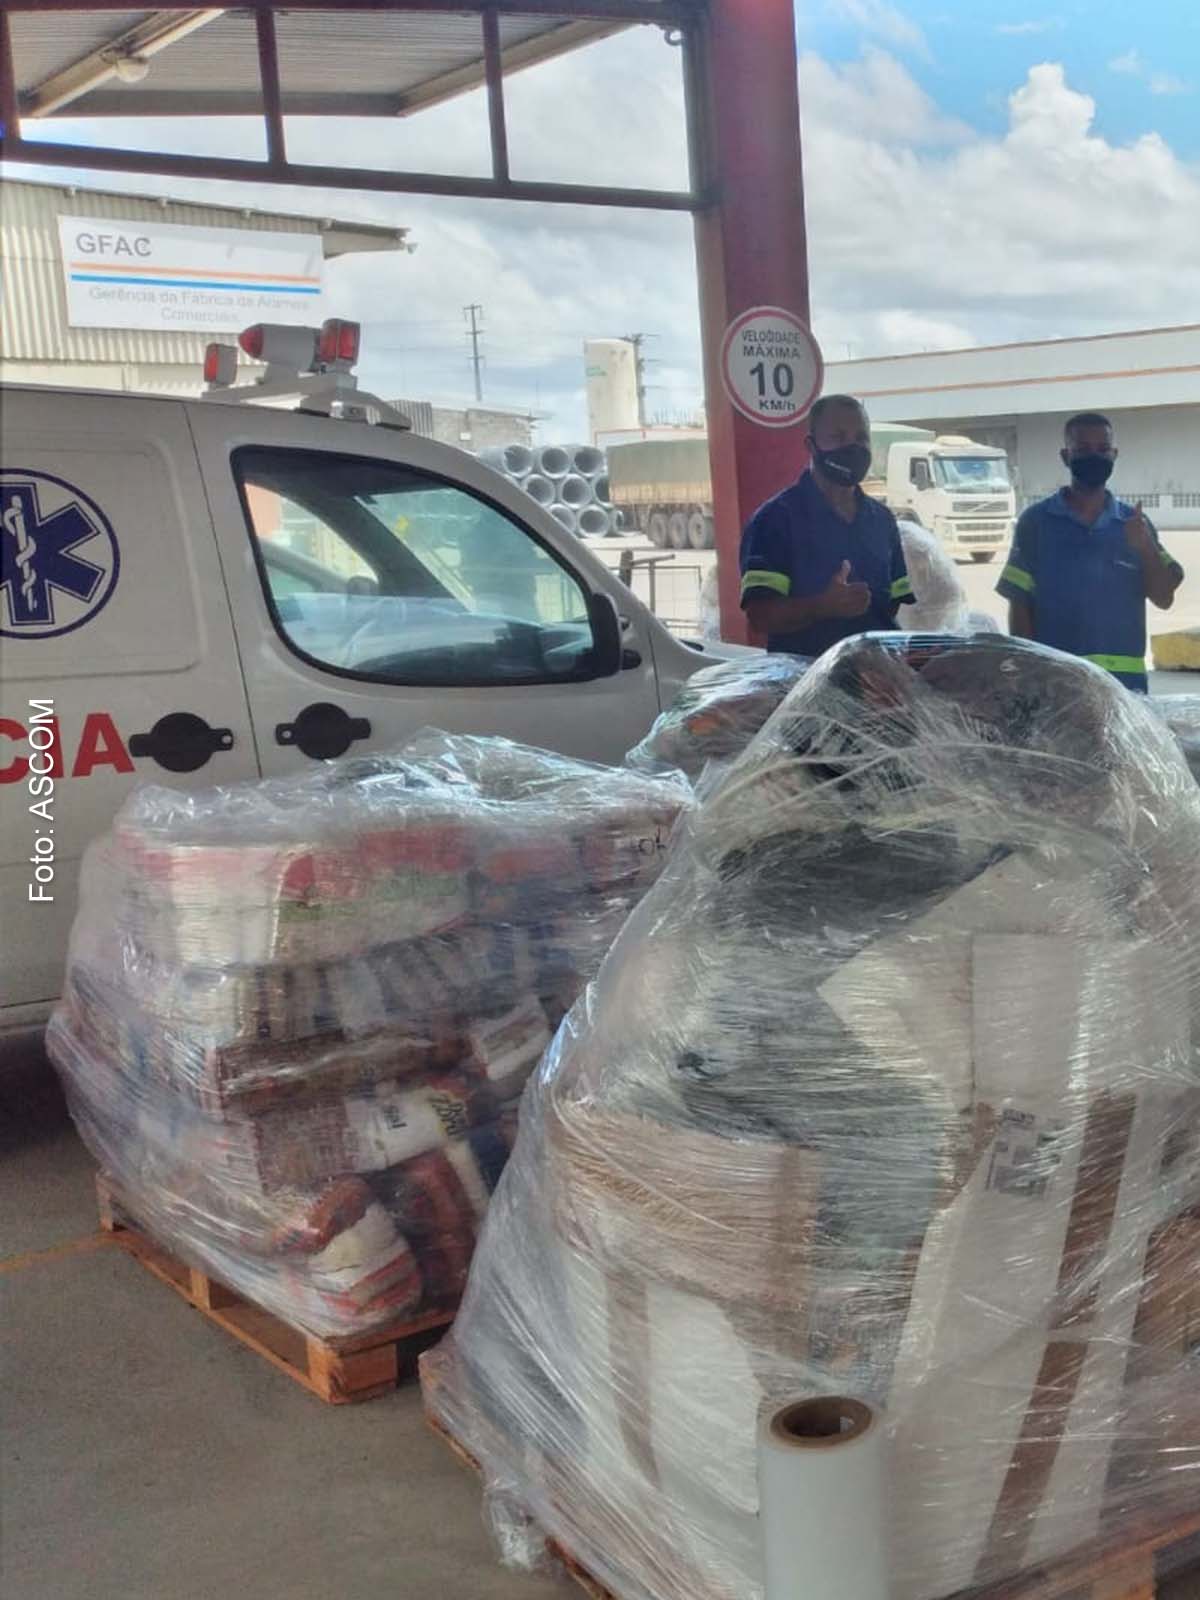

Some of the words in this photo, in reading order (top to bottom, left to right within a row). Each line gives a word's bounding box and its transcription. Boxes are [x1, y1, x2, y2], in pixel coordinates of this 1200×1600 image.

[76, 233, 152, 257] GFAC
[742, 330, 801, 343] VELOCIDADE
[743, 344, 801, 358] MÁXIMA
[749, 361, 794, 397] 10
